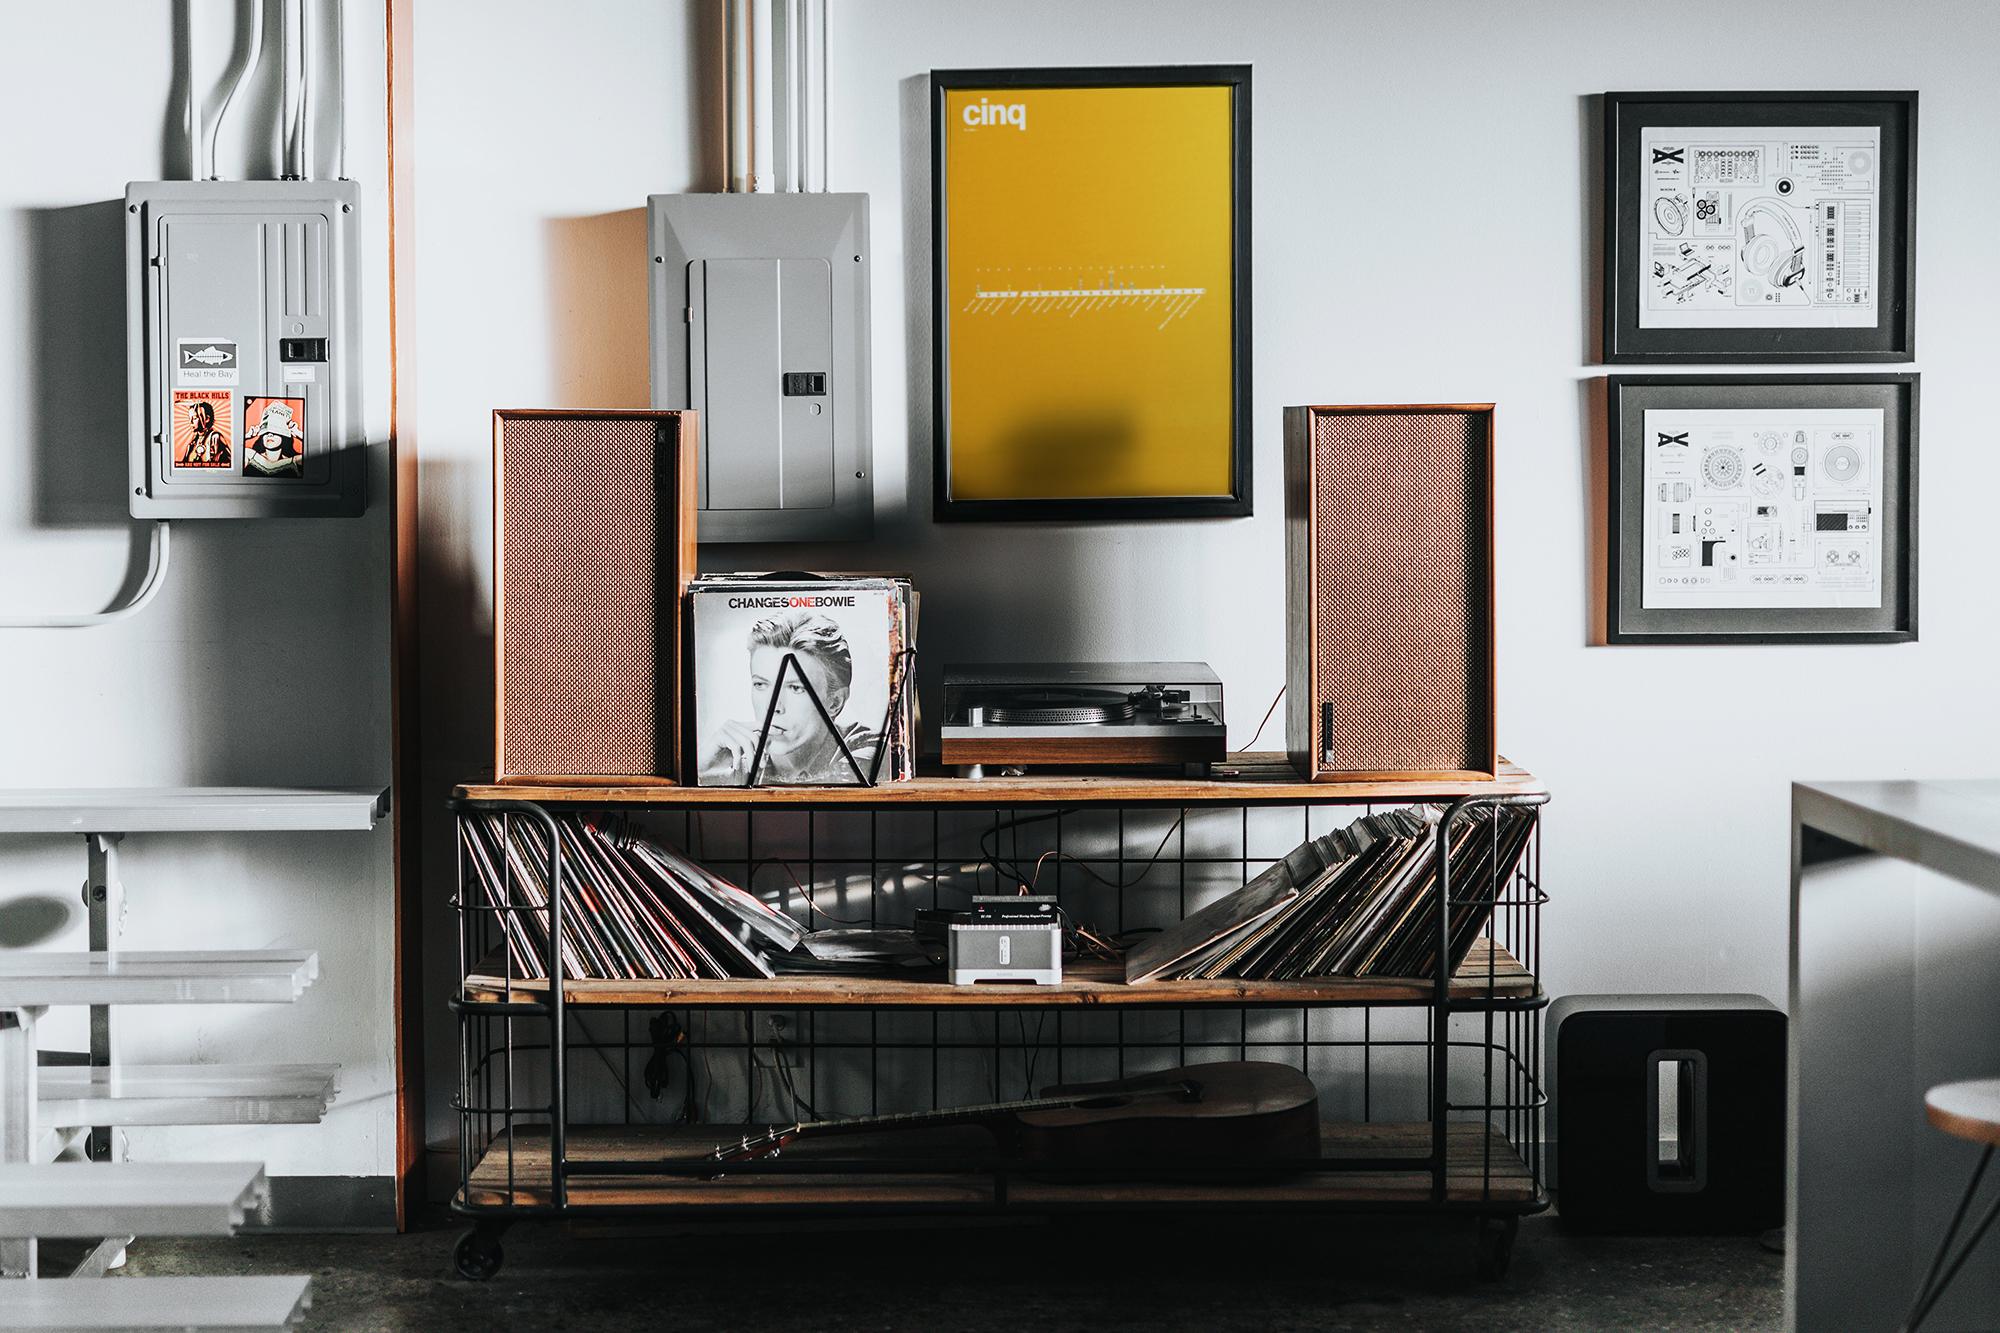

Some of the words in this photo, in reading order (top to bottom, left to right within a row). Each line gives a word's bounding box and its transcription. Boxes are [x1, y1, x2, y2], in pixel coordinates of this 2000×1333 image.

[963, 98, 1026, 131] cinq
[183, 370, 202, 378] Heal
[203, 370, 216, 378] the
[218, 370, 233, 379] Bay
[728, 596, 855, 609] CHANGESONEBOWIE
